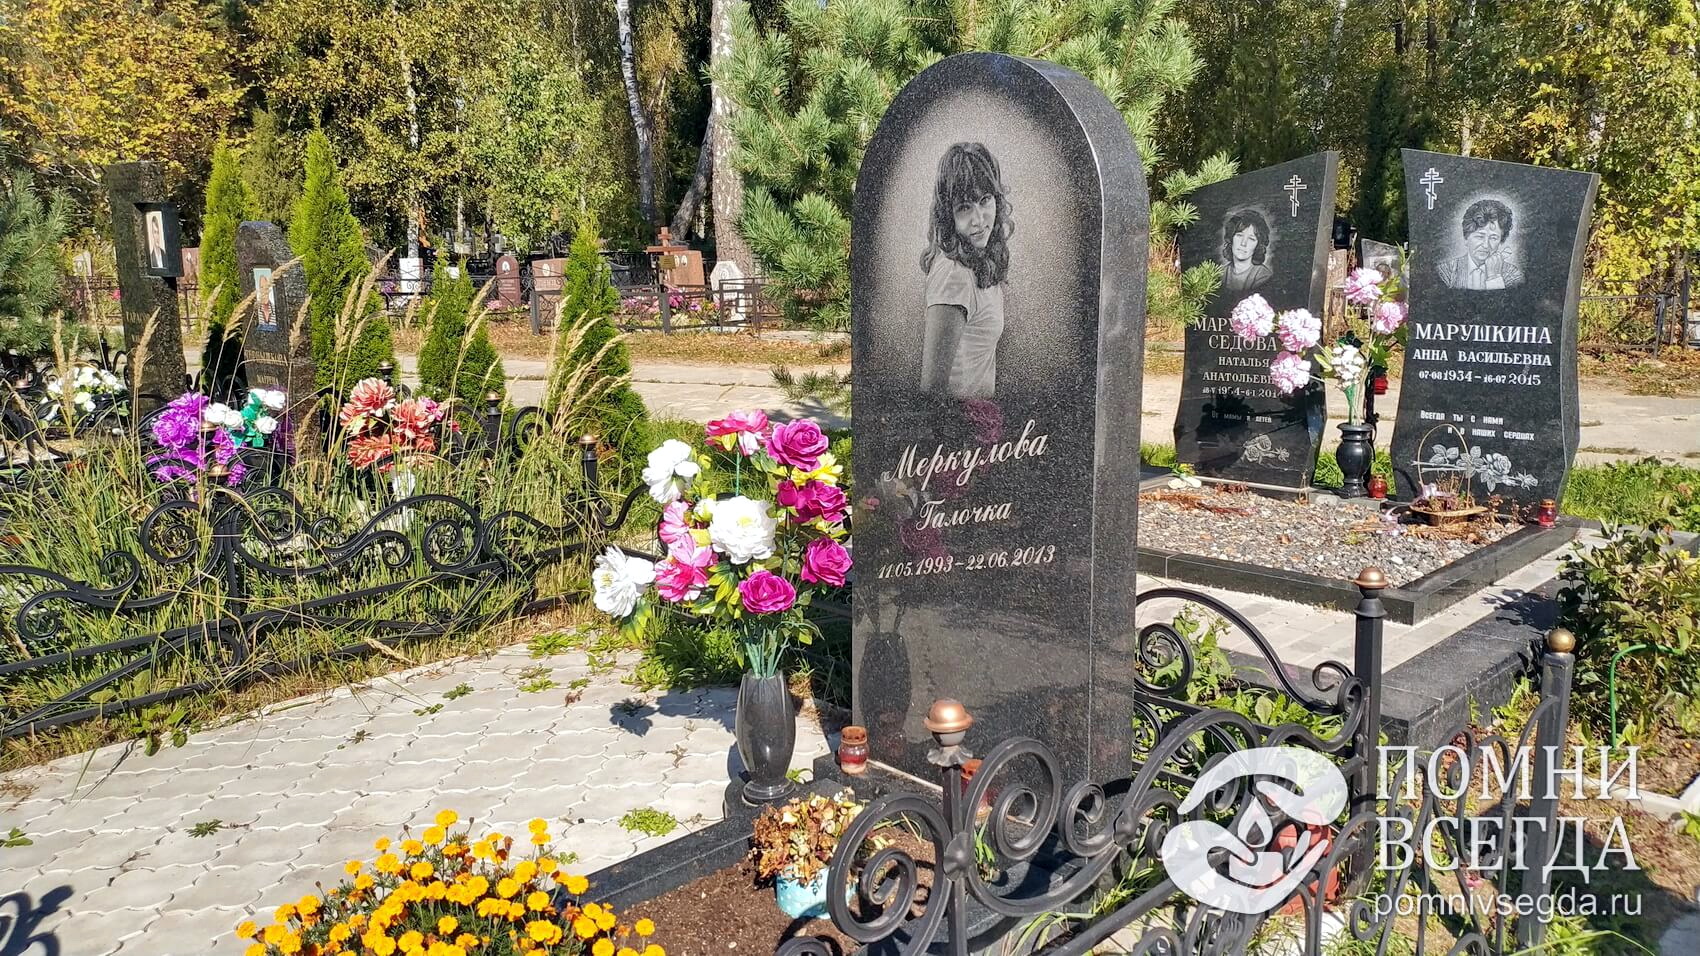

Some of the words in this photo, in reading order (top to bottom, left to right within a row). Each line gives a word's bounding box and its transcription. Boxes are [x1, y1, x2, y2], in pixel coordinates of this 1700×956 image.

[1415, 322, 1553, 345] МАРУШКИНА
[1208, 334, 1277, 353] СЕДОВА
[1218, 356, 1270, 368] НАТАЛЬЯ
[1413, 348, 1449, 362] АННА
[1458, 351, 1553, 367] ВАСИЛЬЕВНА
[1202, 371, 1275, 385] АНАТОЛЬЕВН
[1508, 372, 1542, 386] 2015
[883, 419, 1049, 491] Меркулова
[916, 498, 1013, 531] Галочка
